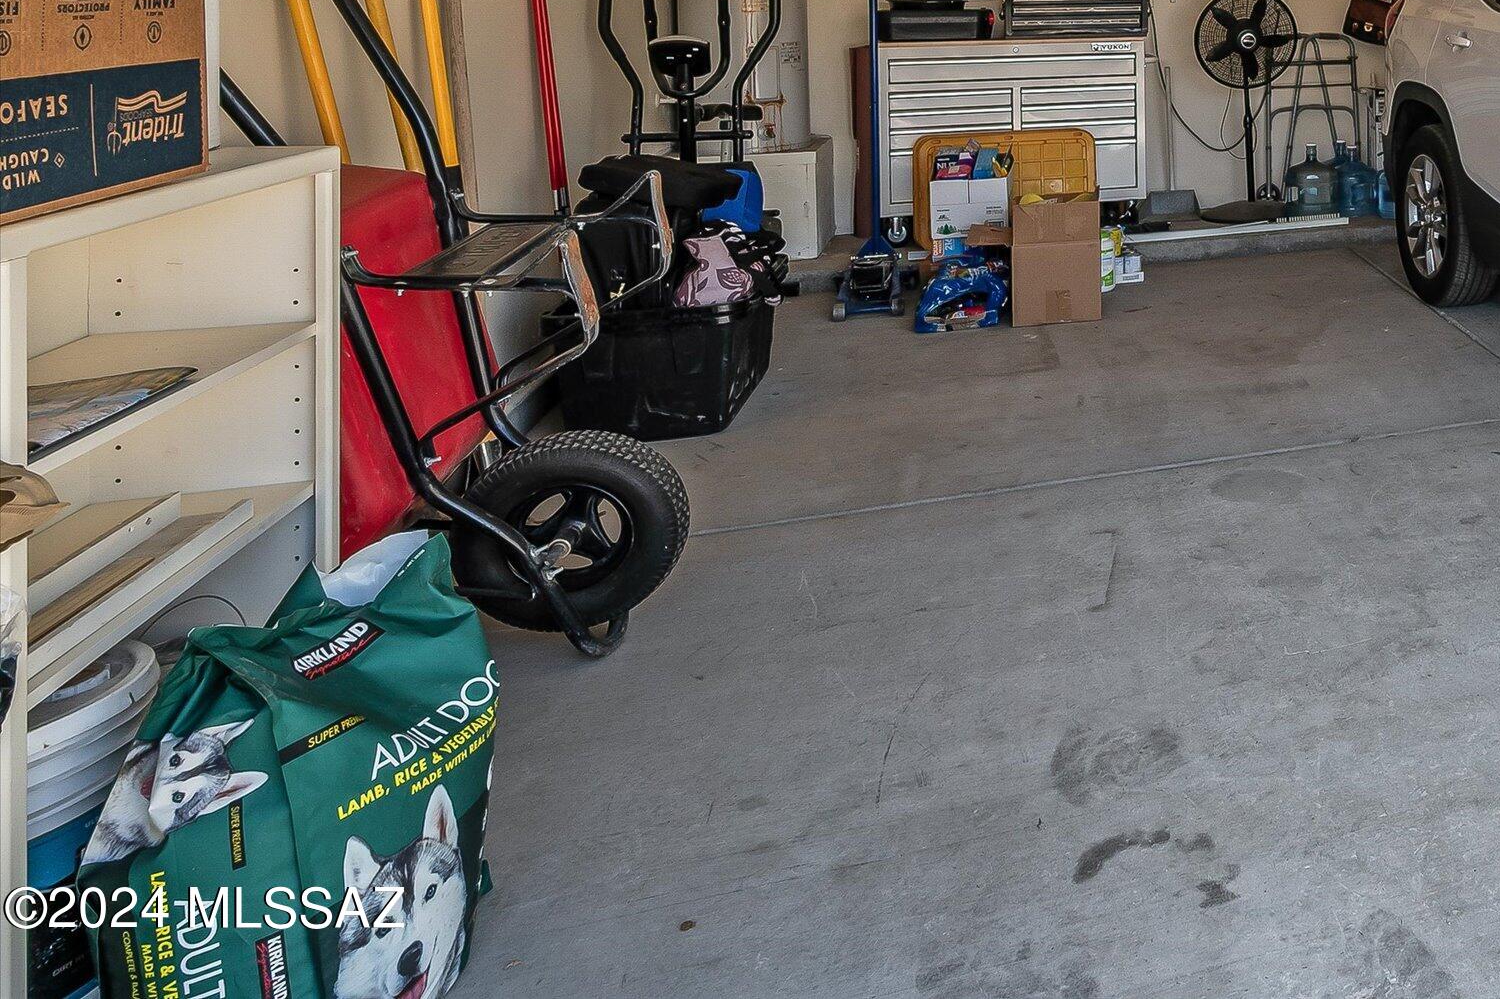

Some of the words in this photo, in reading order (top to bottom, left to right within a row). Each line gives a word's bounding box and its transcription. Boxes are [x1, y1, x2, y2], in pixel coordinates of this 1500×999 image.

[57, 2, 111, 14] PROTECTORS
[1101, 43, 1130, 51] YUKON
[121, 112, 185, 147] Trident
[2, 169, 41, 191] WILD
[293, 621, 369, 673] KIRKLAND
[304, 631, 378, 680] Signature
[307, 725, 341, 749] SUPER
[370, 716, 449, 781] ADULT
[411, 768, 443, 796] MADE
[444, 749, 468, 772] WITH
[468, 734, 487, 755] REAL
[337, 783, 390, 821] LAMB,
[394, 758, 428, 788] RICE
[431, 750, 444, 765] &
[229, 805, 240, 830] SUPER
[231, 829, 243, 864] PREMIUM
[122, 930, 136, 973] COMPLETE
[155, 925, 174, 960] RICE
[141, 943, 155, 979] MADE
[160, 964, 176, 978] &
